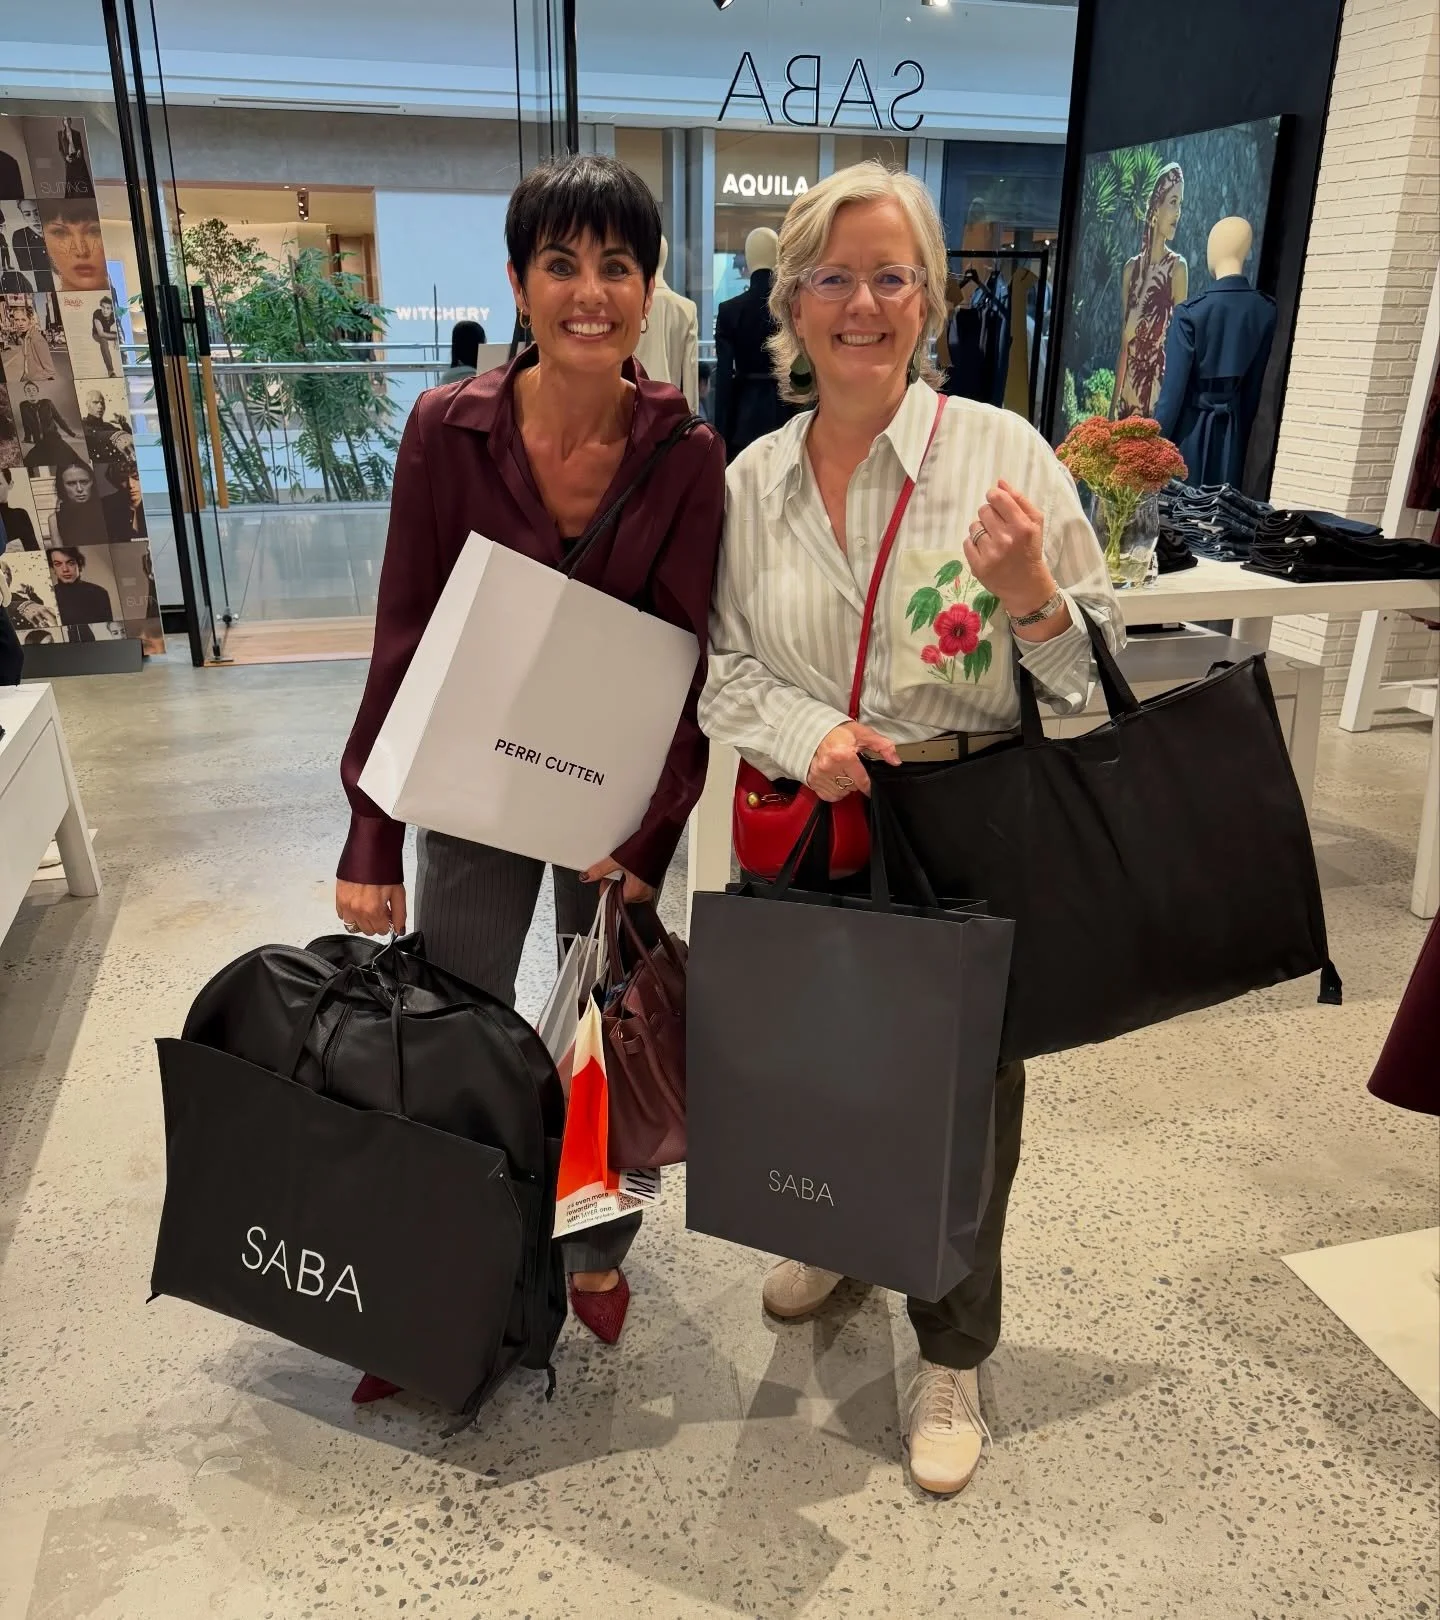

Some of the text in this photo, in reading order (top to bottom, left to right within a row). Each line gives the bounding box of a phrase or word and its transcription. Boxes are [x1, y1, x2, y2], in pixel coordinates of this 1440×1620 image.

[722, 173, 809, 196] AQUILA
[396, 306, 490, 321] WITCHERY
[494, 738, 605, 786] PERRI CUTTEN
[575, 1197, 591, 1206] even
[591, 1192, 609, 1201] more
[768, 1169, 834, 1207] SABA
[566, 1213, 580, 1224] with
[581, 1208, 598, 1219] MYER
[241, 1226, 363, 1313] SABA
